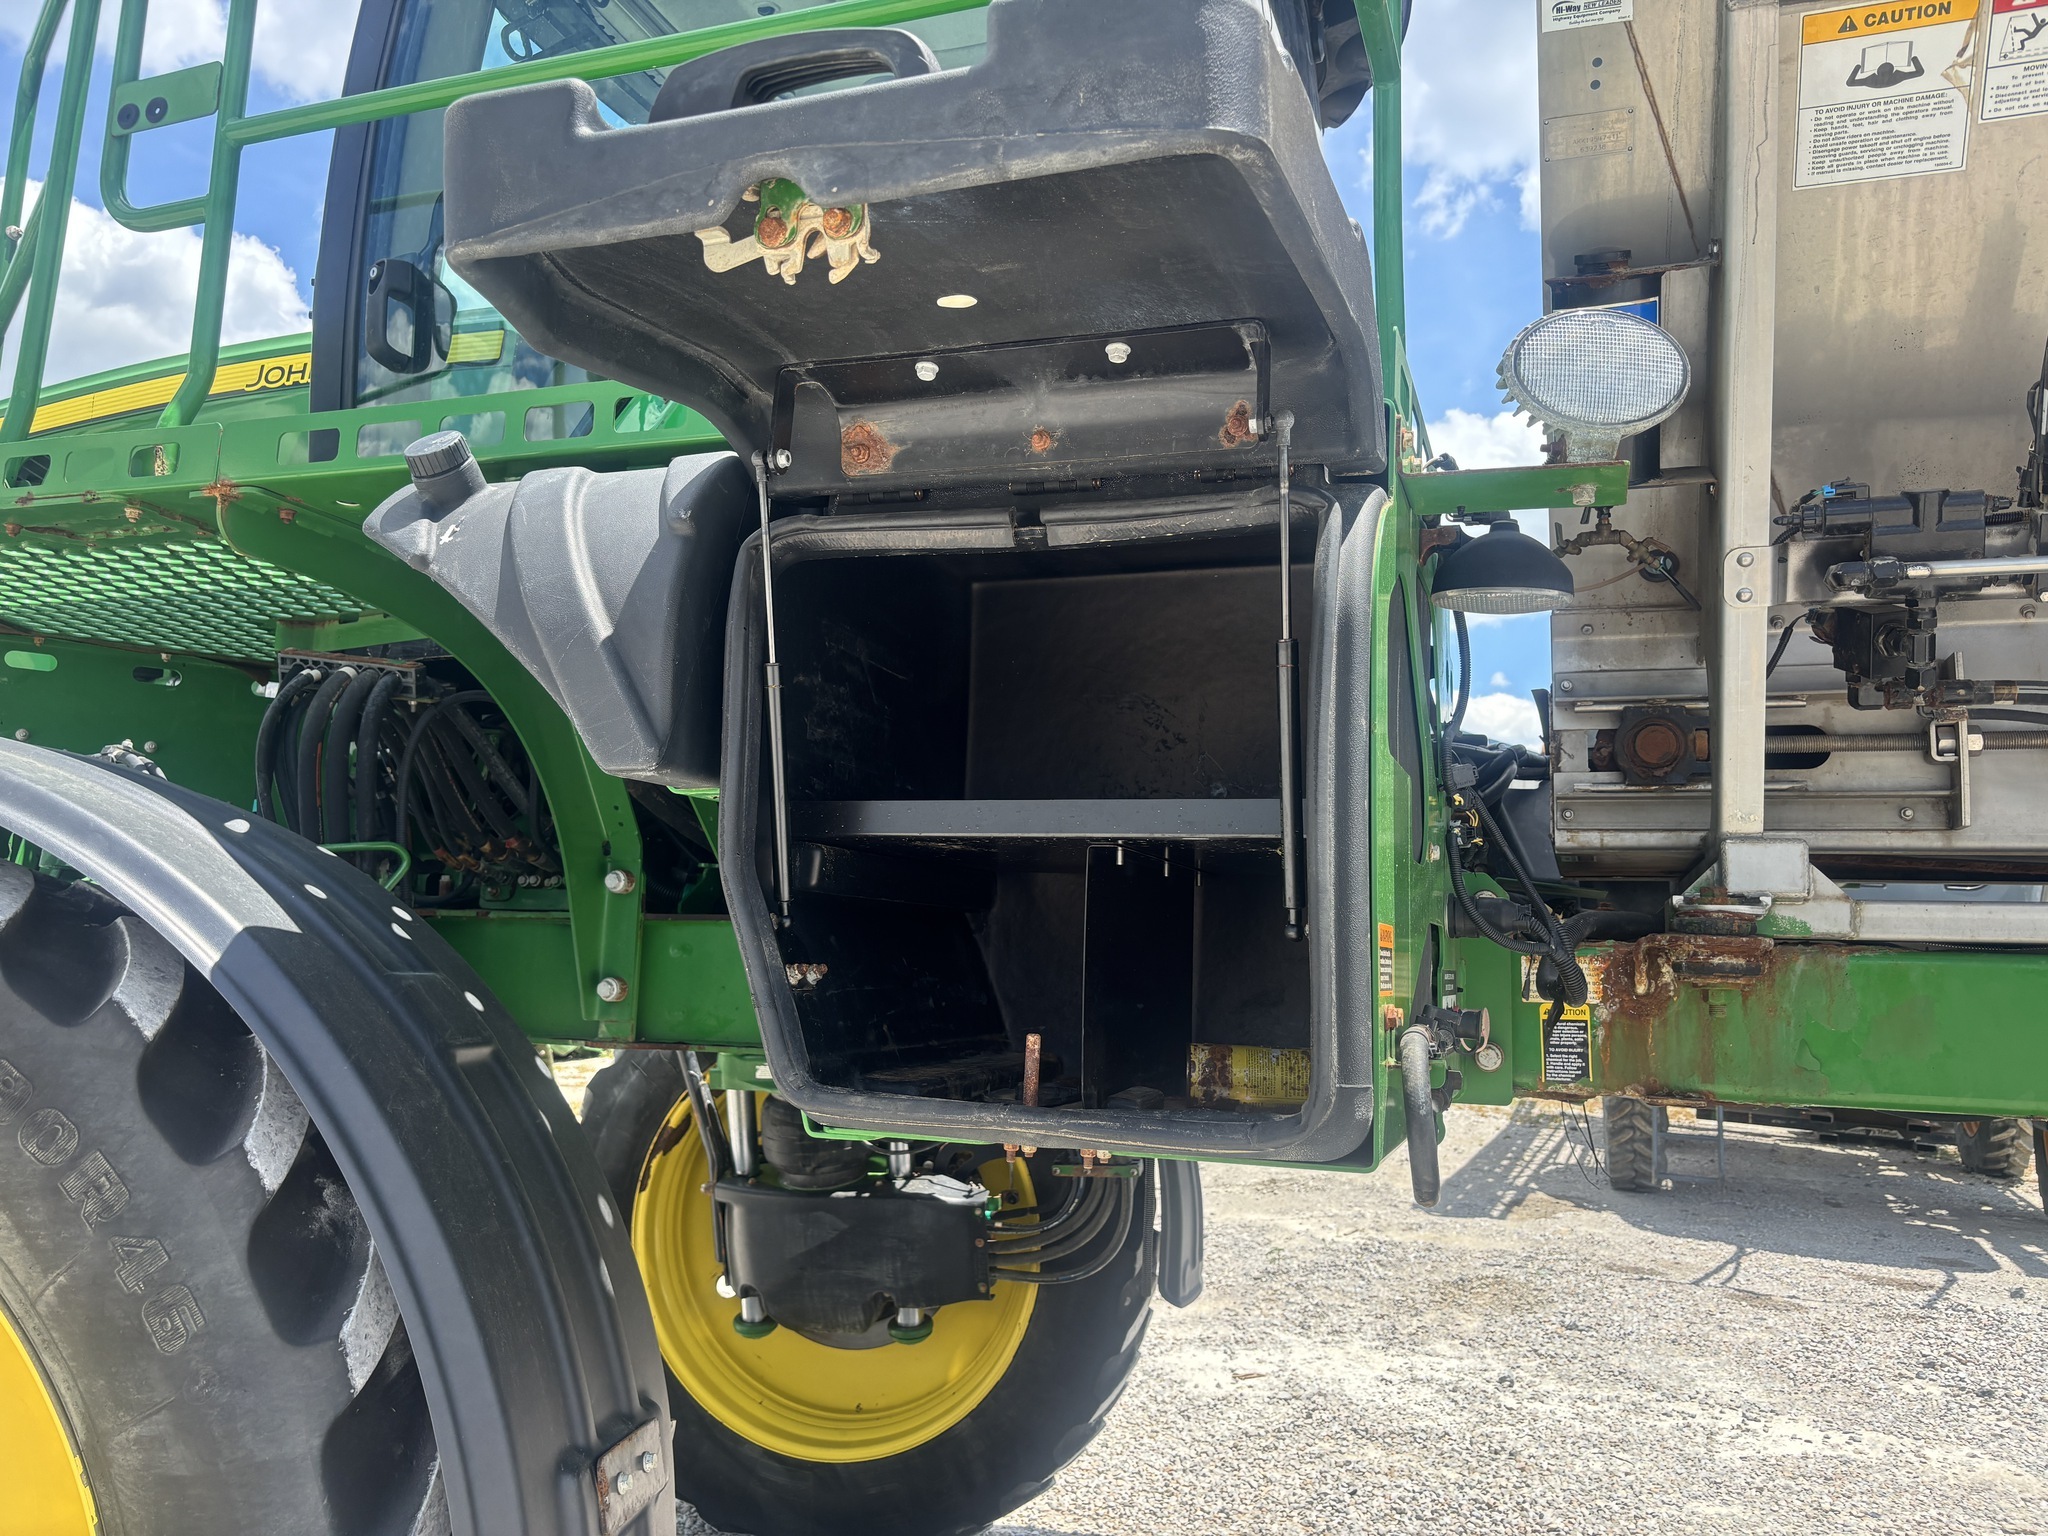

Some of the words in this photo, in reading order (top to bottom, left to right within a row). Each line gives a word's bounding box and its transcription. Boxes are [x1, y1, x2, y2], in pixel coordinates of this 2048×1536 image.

[1584, 1, 1598, 10] NEW
[1599, 0, 1622, 8] LEADER
[1864, 2, 1951, 27] CAUTION
[1995, 90, 2027, 98] Disconnect
[1847, 103, 1870, 111] INJURY
[1883, 97, 1914, 106] MACHINE
[1915, 93, 1948, 101] DAMAGE:
[1995, 97, 2021, 105] adjusting
[1850, 114, 1889, 123] understanding
[1881, 132, 1917, 140] maintenance.
[1893, 142, 1924, 150] unclogging
[1829, 155, 1865, 163] unauthorized
[1914, 156, 1949, 164] replacement.
[245, 363, 311, 388] JOH
